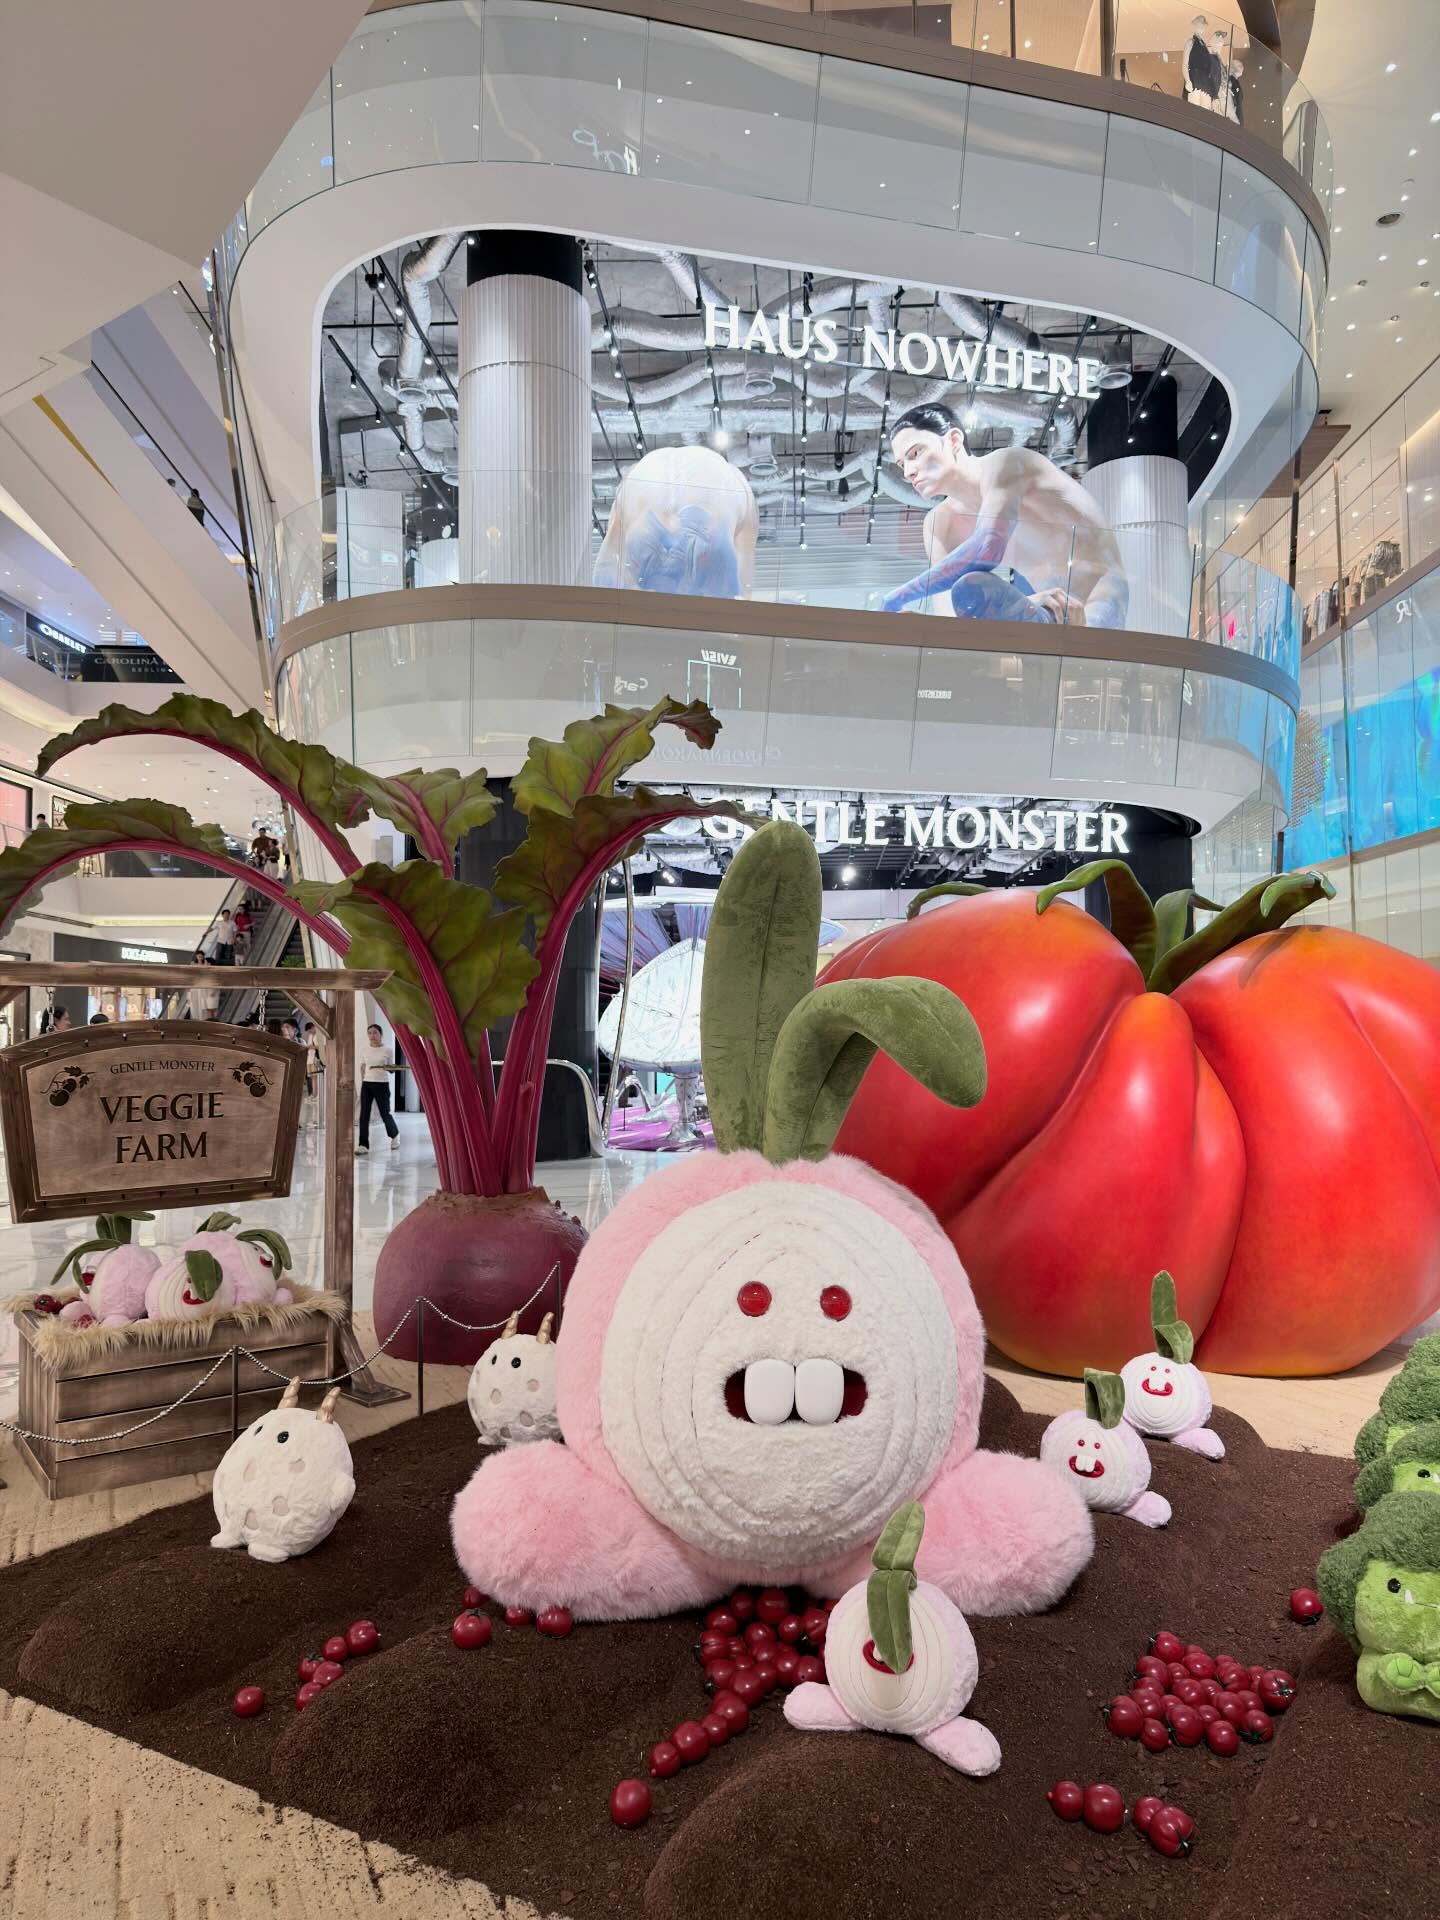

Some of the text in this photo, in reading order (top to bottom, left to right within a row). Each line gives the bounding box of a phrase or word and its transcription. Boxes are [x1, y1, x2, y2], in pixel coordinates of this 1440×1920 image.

[704, 302, 1101, 399] HAUS NOWHERE
[94, 656, 158, 665] CAROLINA
[905, 806, 1130, 854] MONSTER
[110, 1059, 215, 1075] GENTLE MONSTER
[100, 1092, 224, 1125] VEGGIE
[116, 1131, 207, 1164] FARM
